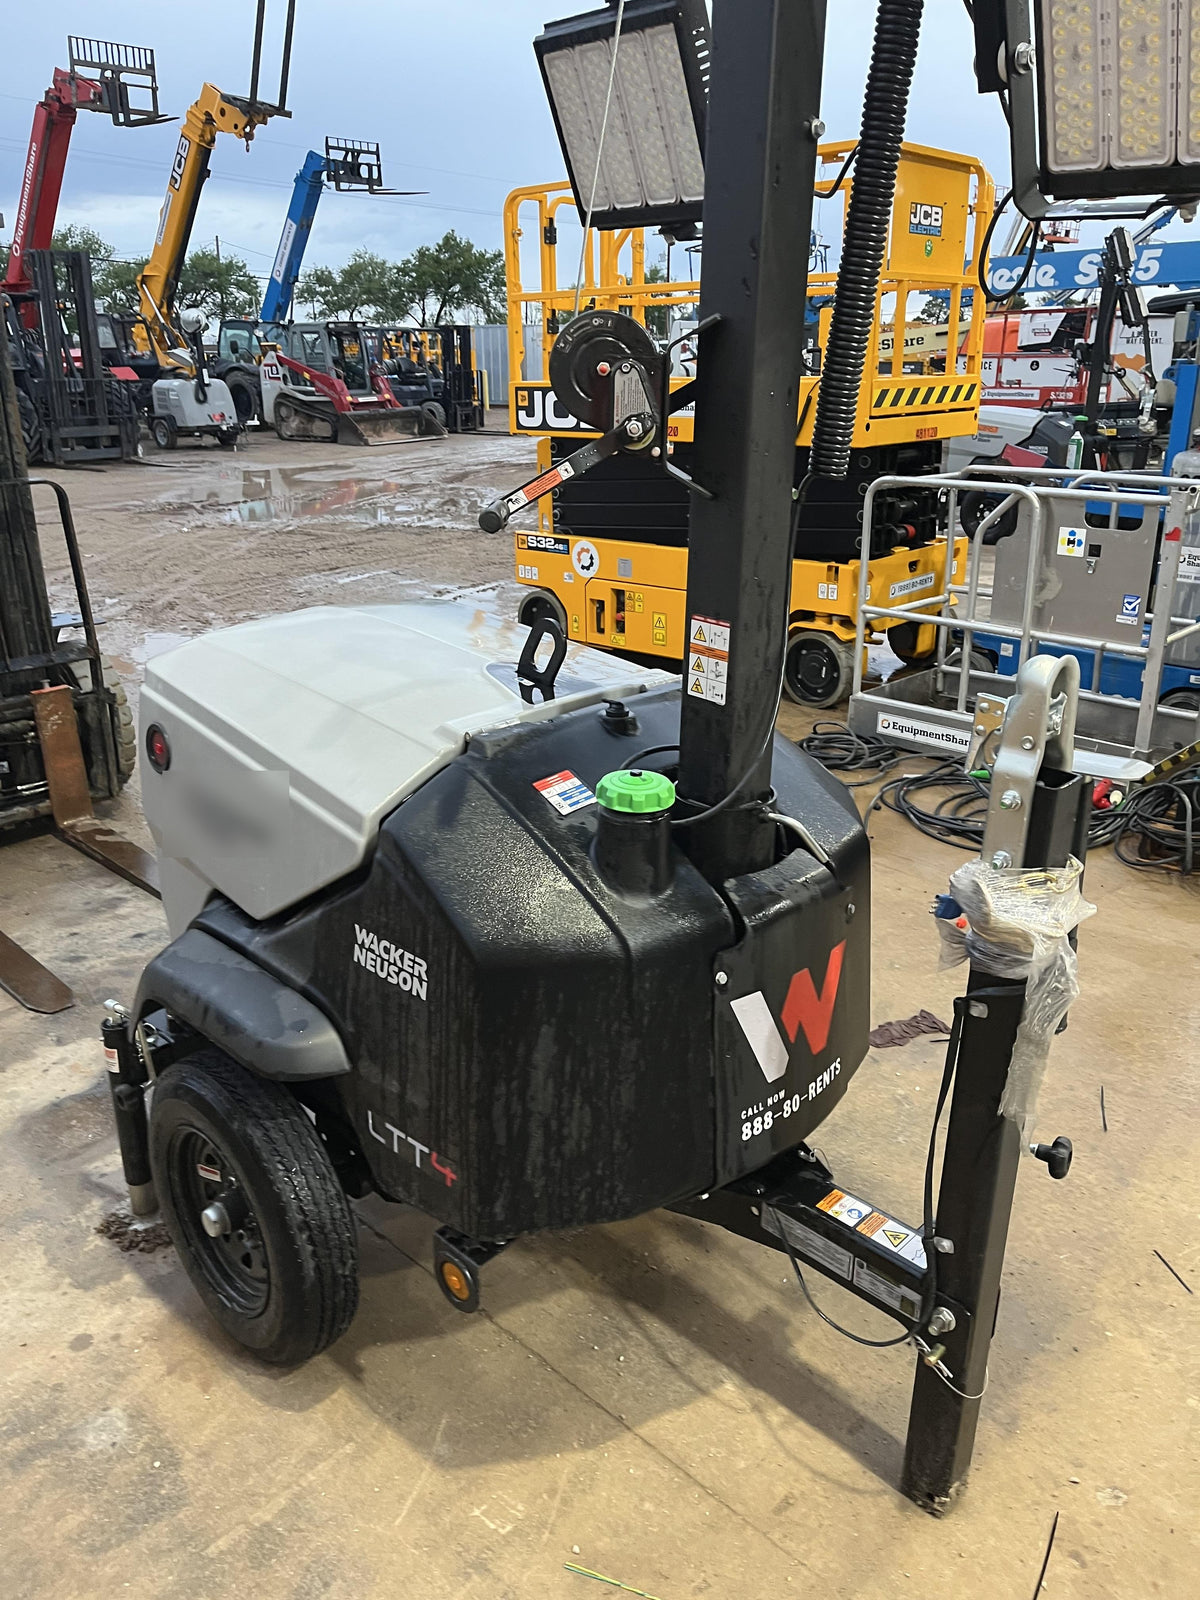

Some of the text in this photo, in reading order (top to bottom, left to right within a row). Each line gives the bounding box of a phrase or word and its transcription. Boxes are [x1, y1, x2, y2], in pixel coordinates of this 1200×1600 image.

[172, 137, 190, 189] JCB
[15, 142, 37, 244] EquipmentShare
[911, 204, 943, 227] JCB
[910, 224, 941, 236] ELECTRIC
[987, 260, 1056, 290] enie
[518, 390, 596, 428] JC
[892, 721, 970, 747] EquipmentShar
[353, 943, 428, 1001] NEUSON
[354, 923, 428, 981] WACKER
[741, 1057, 841, 1141] 888-80-RENTS
[741, 1089, 785, 1120] CALL NOW
[367, 1110, 457, 1187] LTT4
